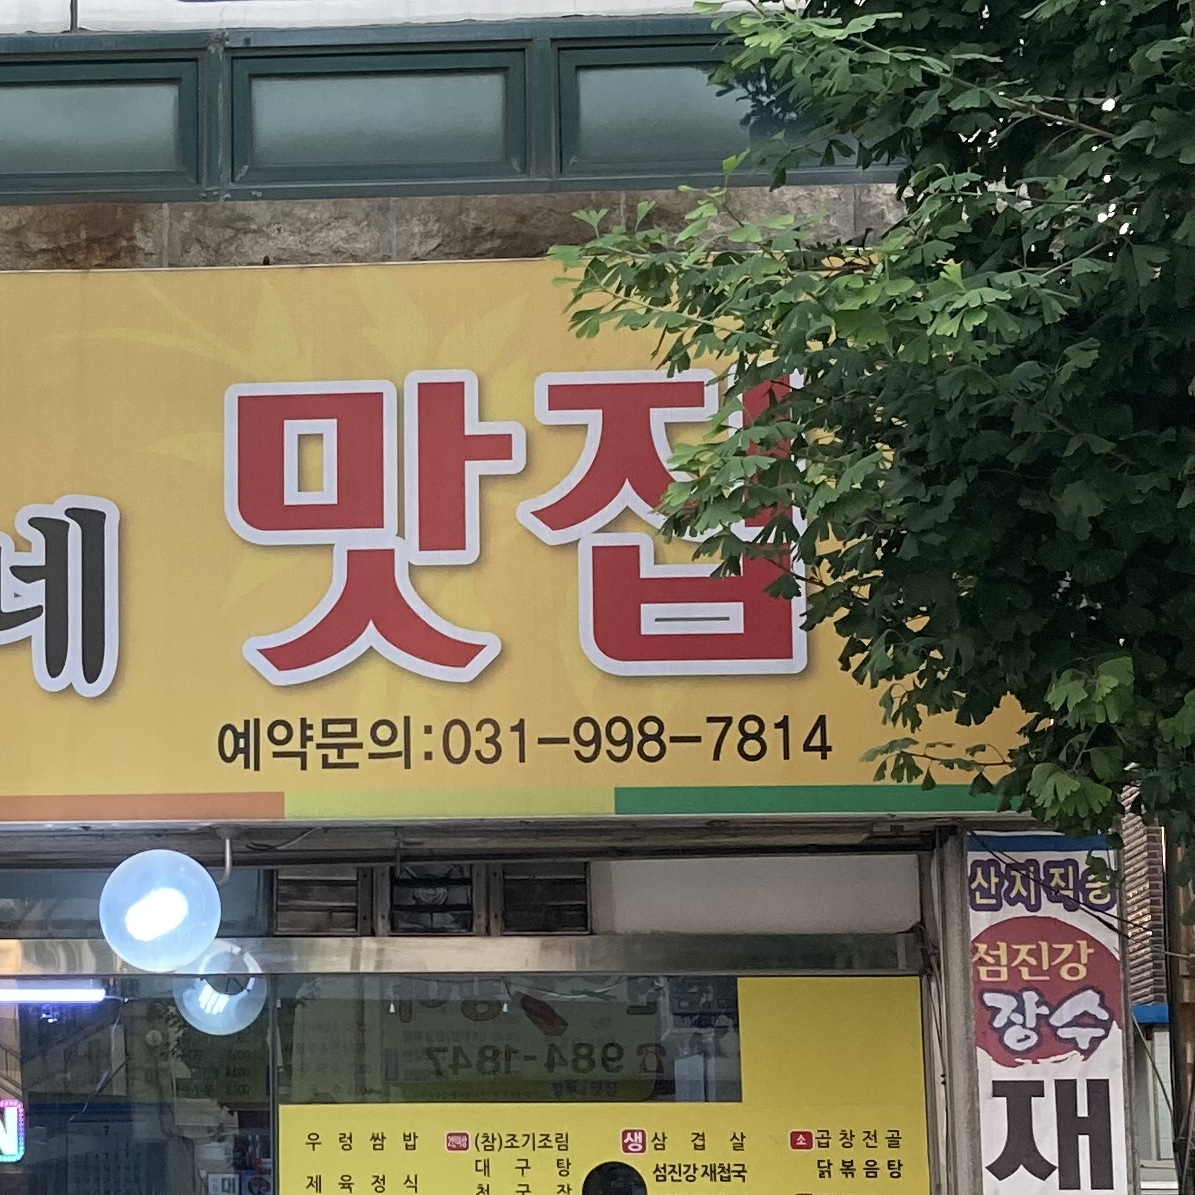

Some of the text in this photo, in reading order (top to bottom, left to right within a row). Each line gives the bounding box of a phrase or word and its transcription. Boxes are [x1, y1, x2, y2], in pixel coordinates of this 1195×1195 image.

[224, 369, 808, 686] 맛집
[973, 940, 1094, 982] 섬진강
[981, 989, 1110, 1051] 장수
[474, 1131, 570, 1153] (참)조기조림
[623, 1132, 644, 1150] 생
